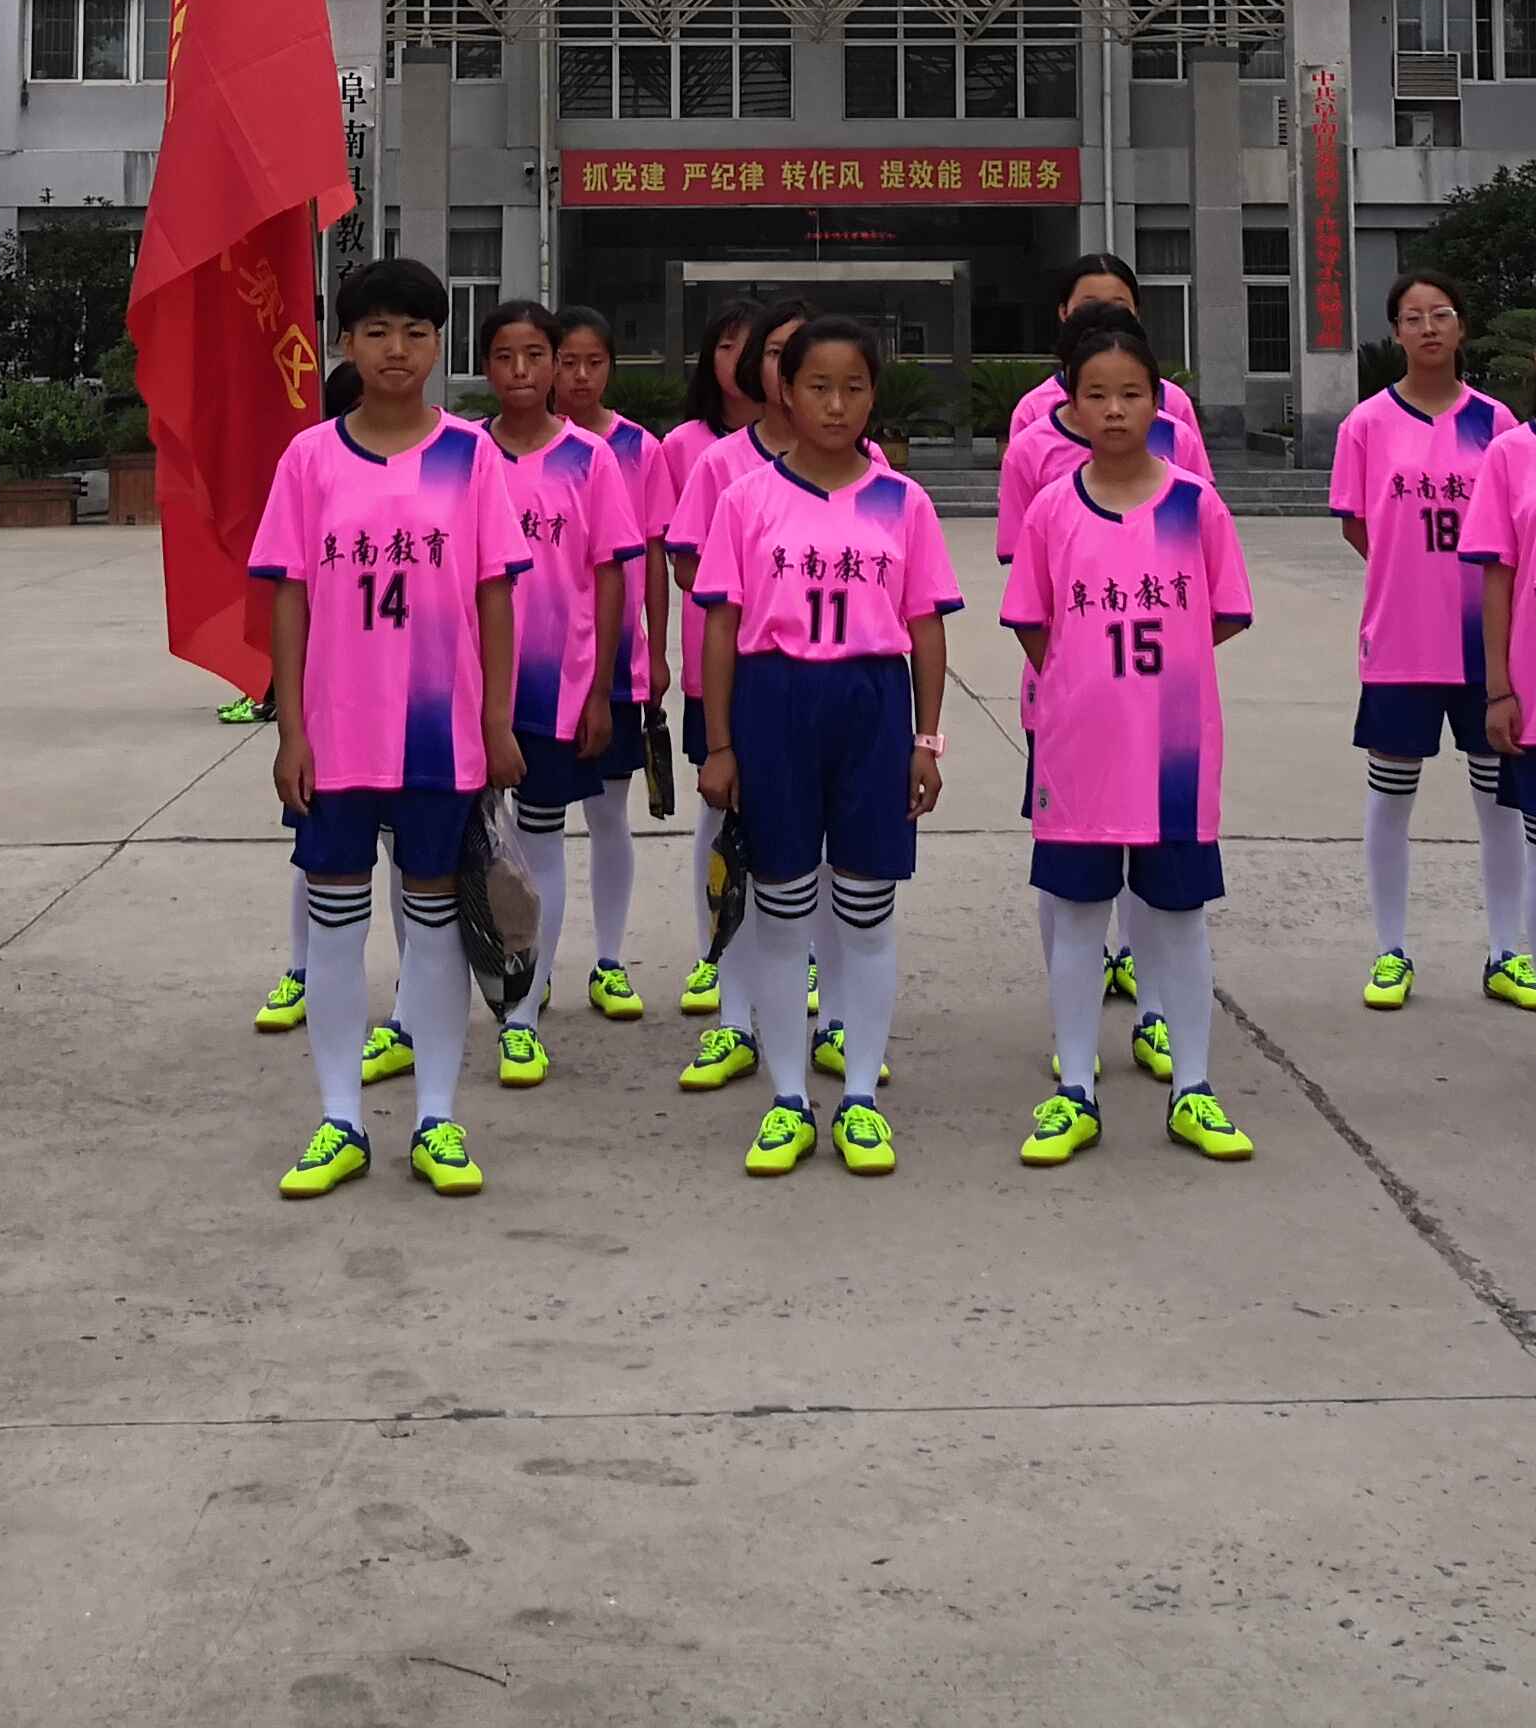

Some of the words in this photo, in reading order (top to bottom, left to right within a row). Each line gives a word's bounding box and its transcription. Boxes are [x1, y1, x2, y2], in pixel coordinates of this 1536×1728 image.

[582, 161, 666, 192] 抓党建
[682, 161, 765, 191] 严纪律
[781, 160, 864, 191] 转作风
[880, 159, 963, 190] 提效能
[979, 159, 1063, 190] 促服务
[1391, 472, 1476, 503] 阜南教
[320, 528, 450, 570] 阜南教育
[1420, 507, 1461, 552] 18
[772, 544, 893, 588] 阜南教育
[358, 571, 409, 631] 14
[806, 587, 848, 644] 11
[1068, 571, 1192, 617] 阜南教育
[1106, 617, 1163, 679] 15
